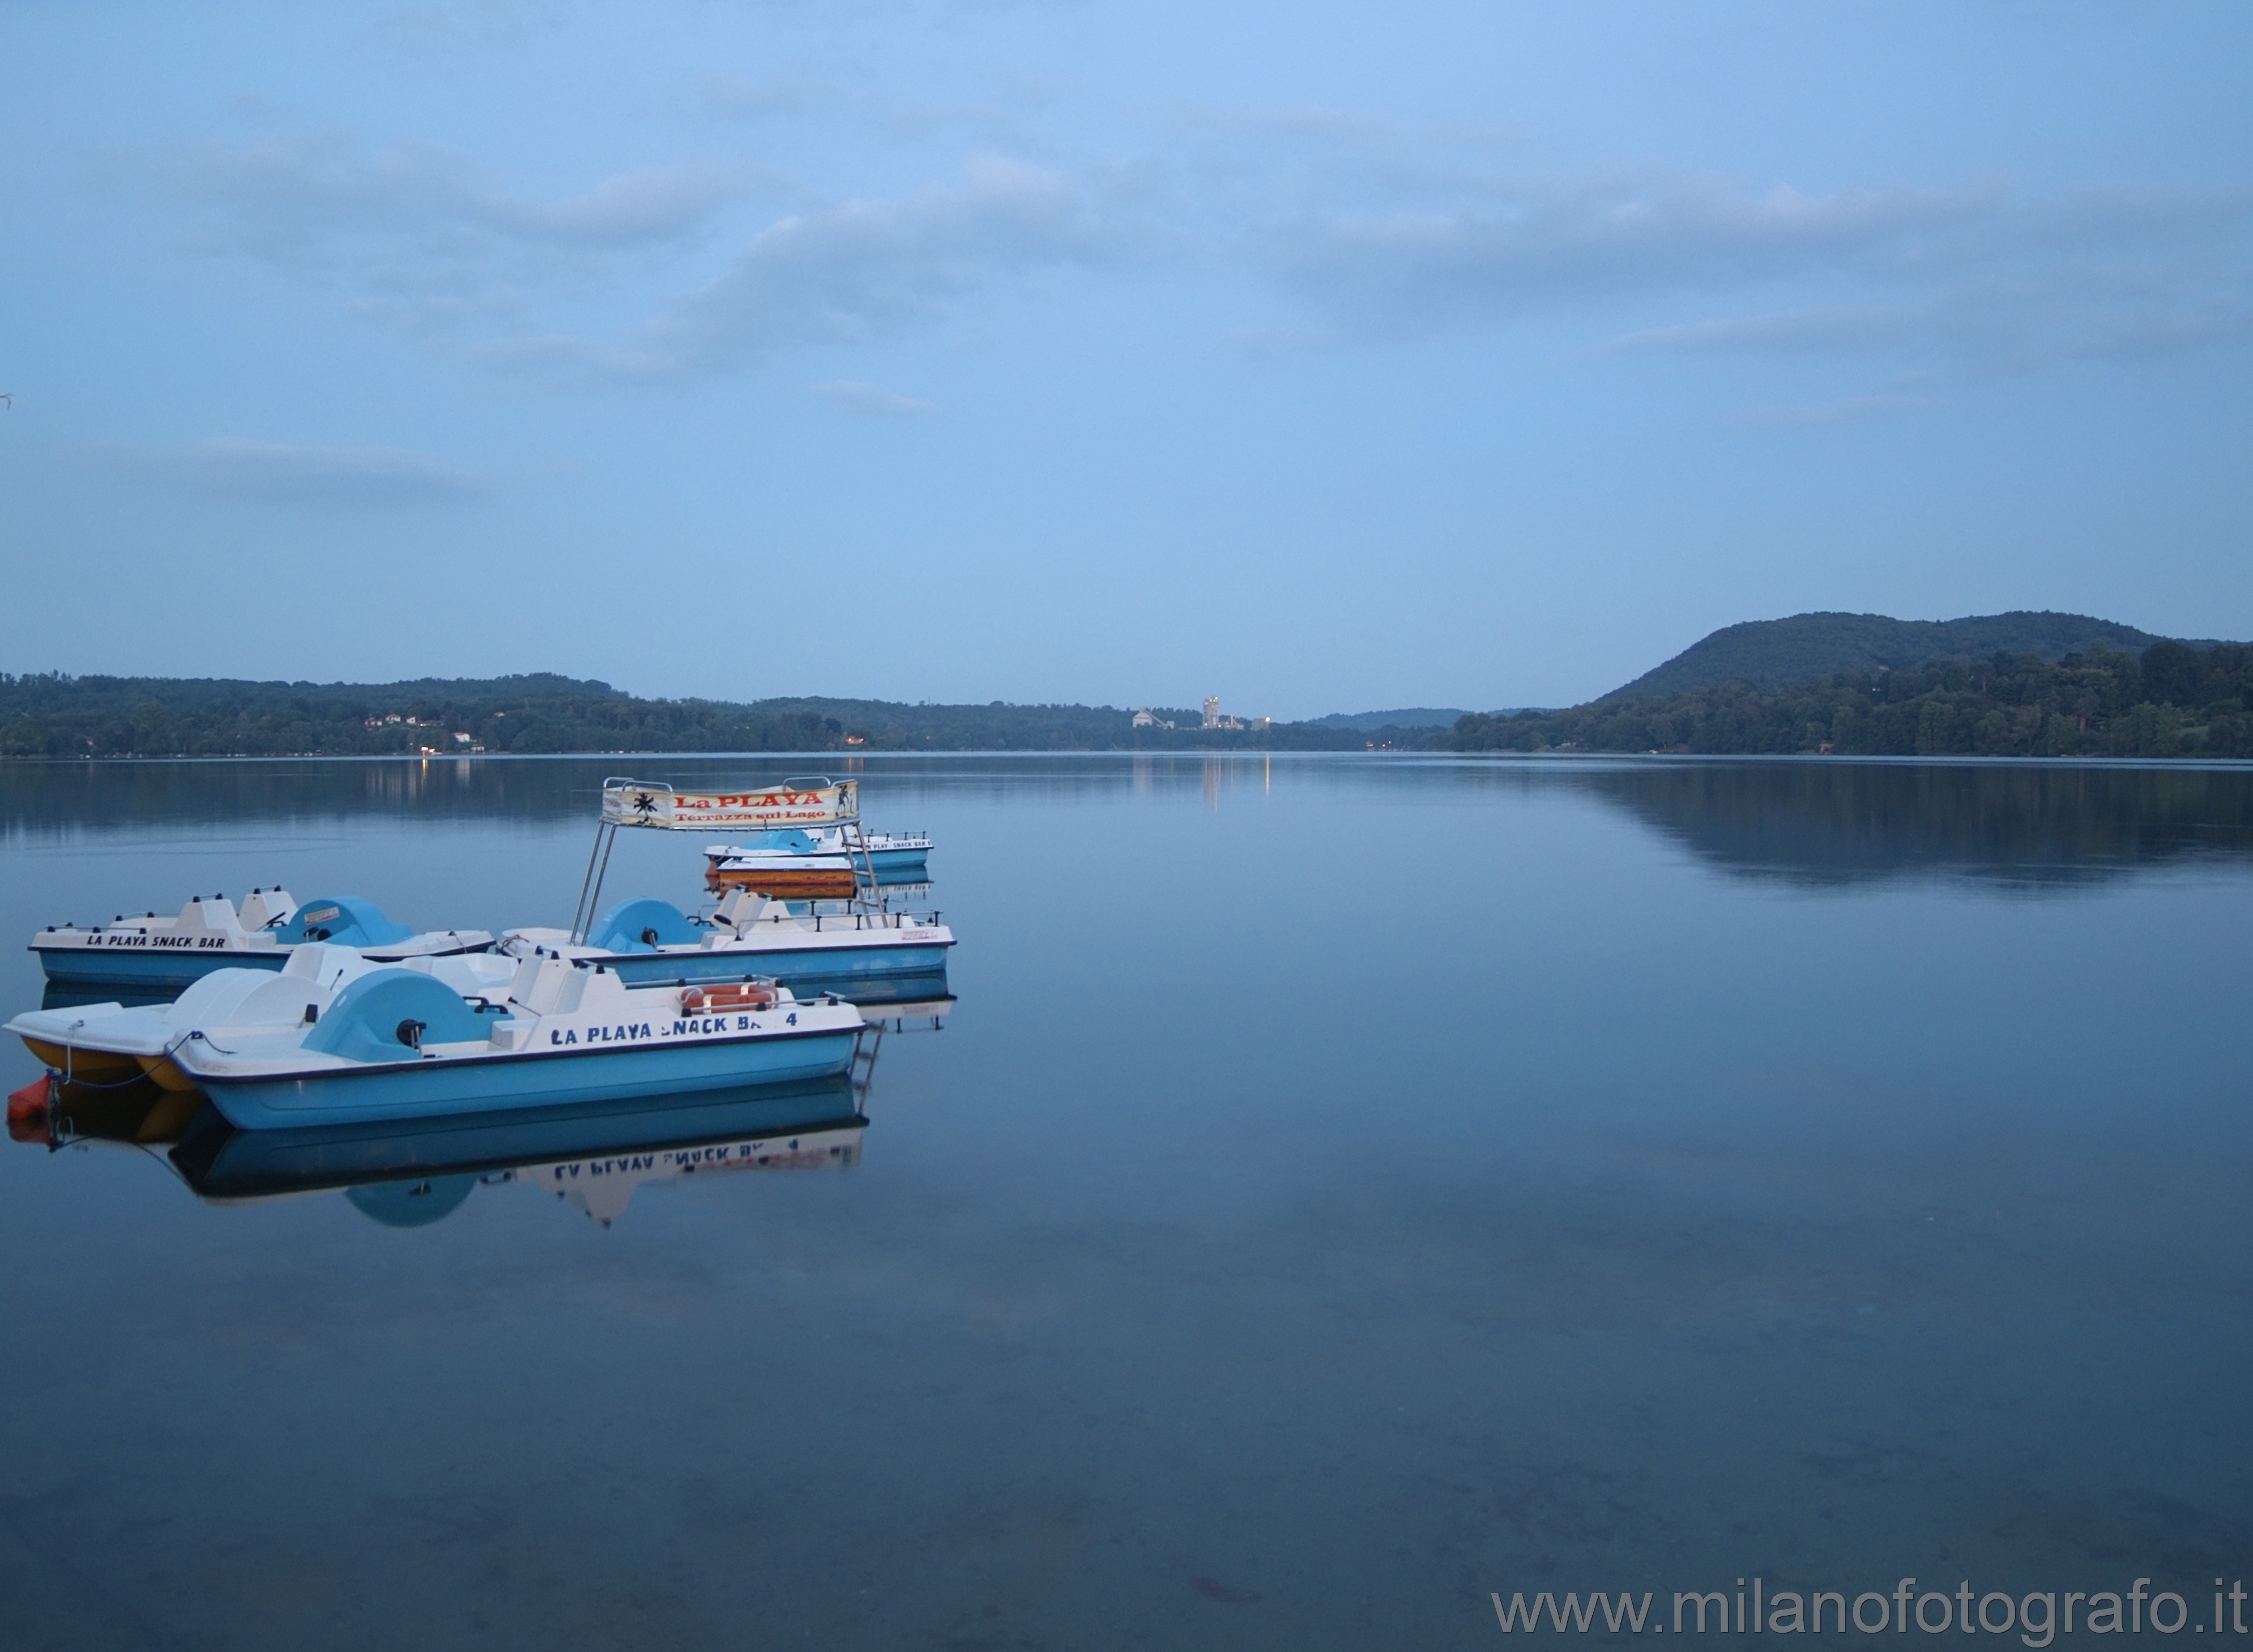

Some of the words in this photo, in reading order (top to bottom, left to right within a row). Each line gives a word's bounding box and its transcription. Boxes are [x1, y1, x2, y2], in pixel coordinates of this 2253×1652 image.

[675, 796, 712, 809] La
[718, 792, 824, 808] PLAYA
[675, 813, 752, 822] Terrazza
[756, 811, 782, 820] sul
[785, 810, 826, 819] Lago
[87, 935, 103, 946] LA
[108, 935, 147, 946] PLAYA
[151, 936, 193, 948] SNACK
[198, 937, 225, 949] BAR
[551, 1028, 578, 1045] LA
[587, 1022, 652, 1043] PLAYA
[786, 1012, 797, 1027] 4
